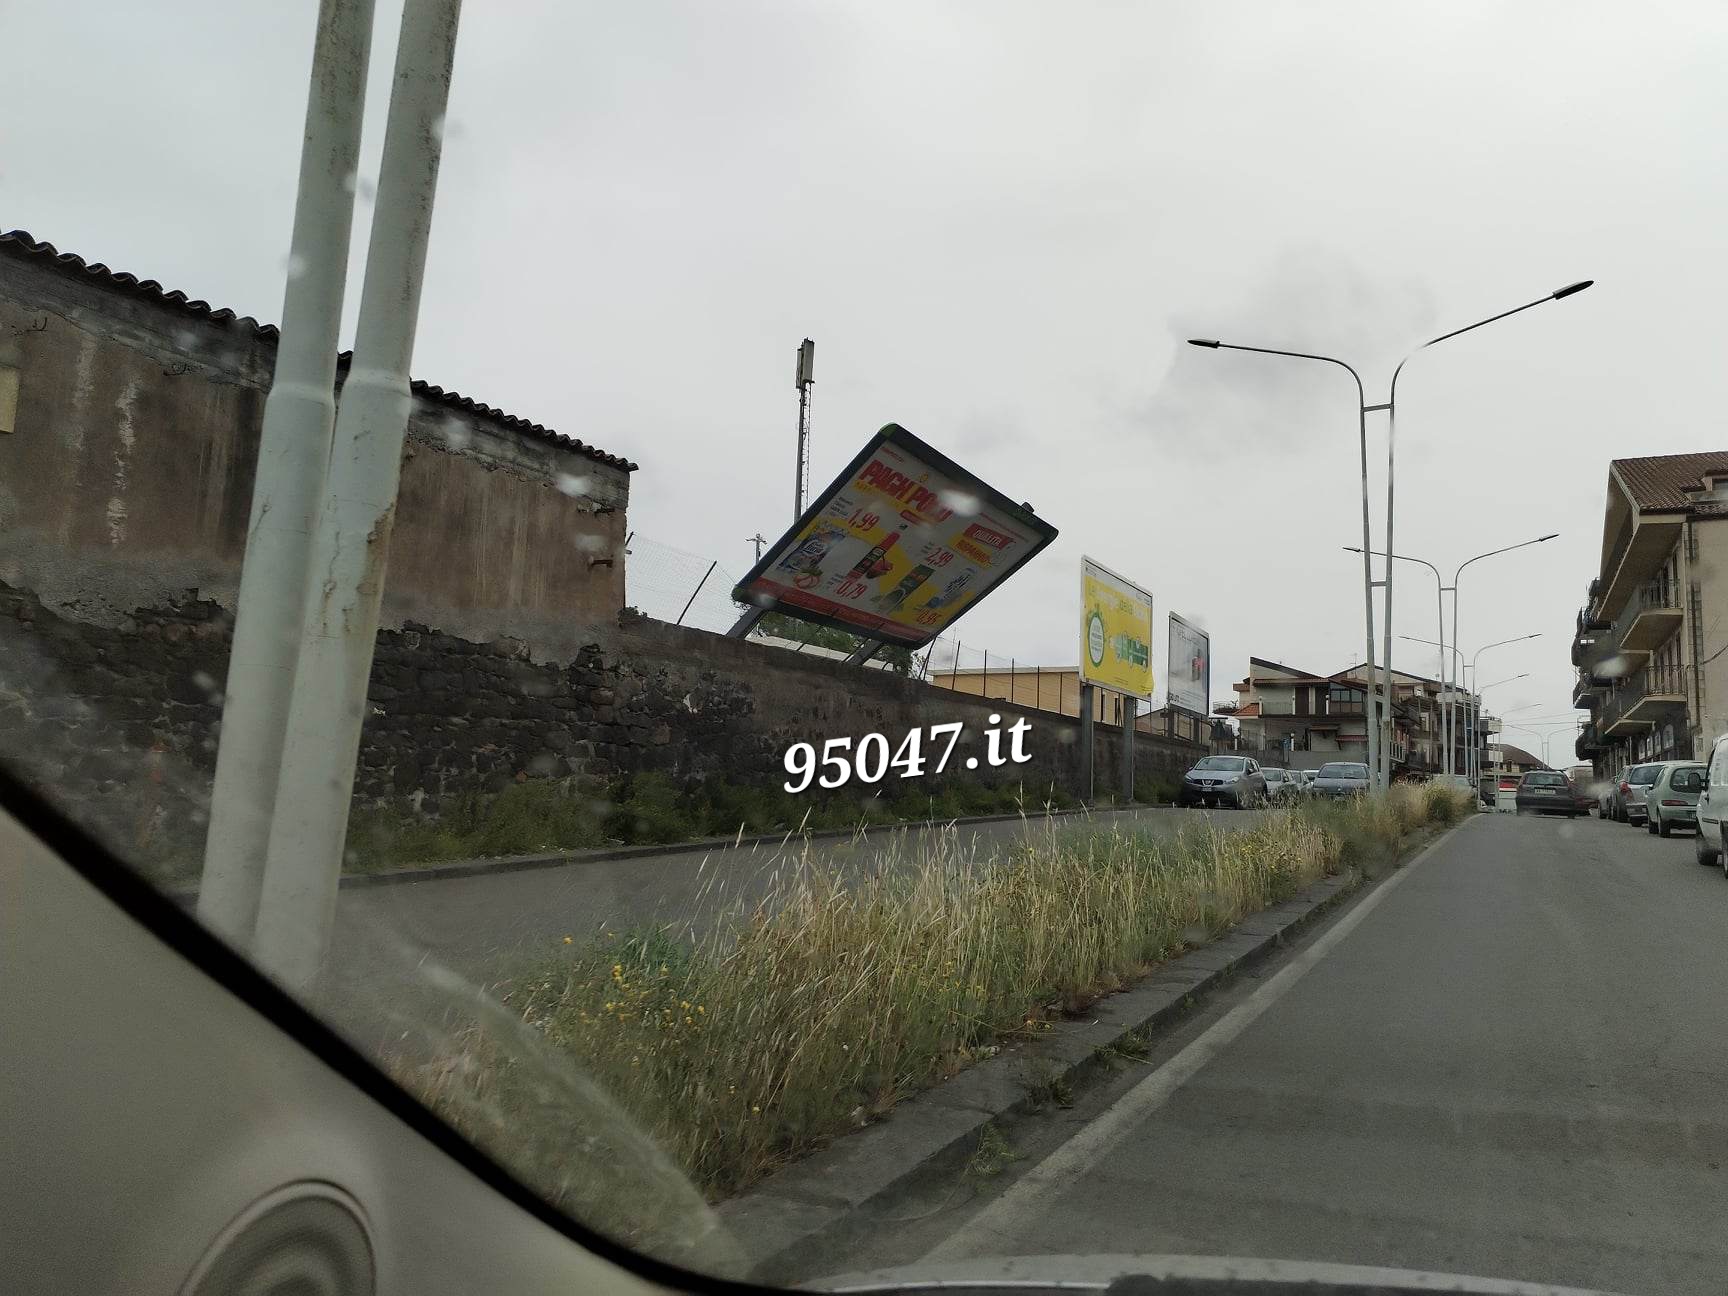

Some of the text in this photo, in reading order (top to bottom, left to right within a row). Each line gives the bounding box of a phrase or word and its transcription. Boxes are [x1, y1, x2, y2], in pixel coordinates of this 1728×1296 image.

[848, 508, 880, 532] 1,99
[926, 547, 954, 568] 2,99
[835, 578, 868, 600] 0,79
